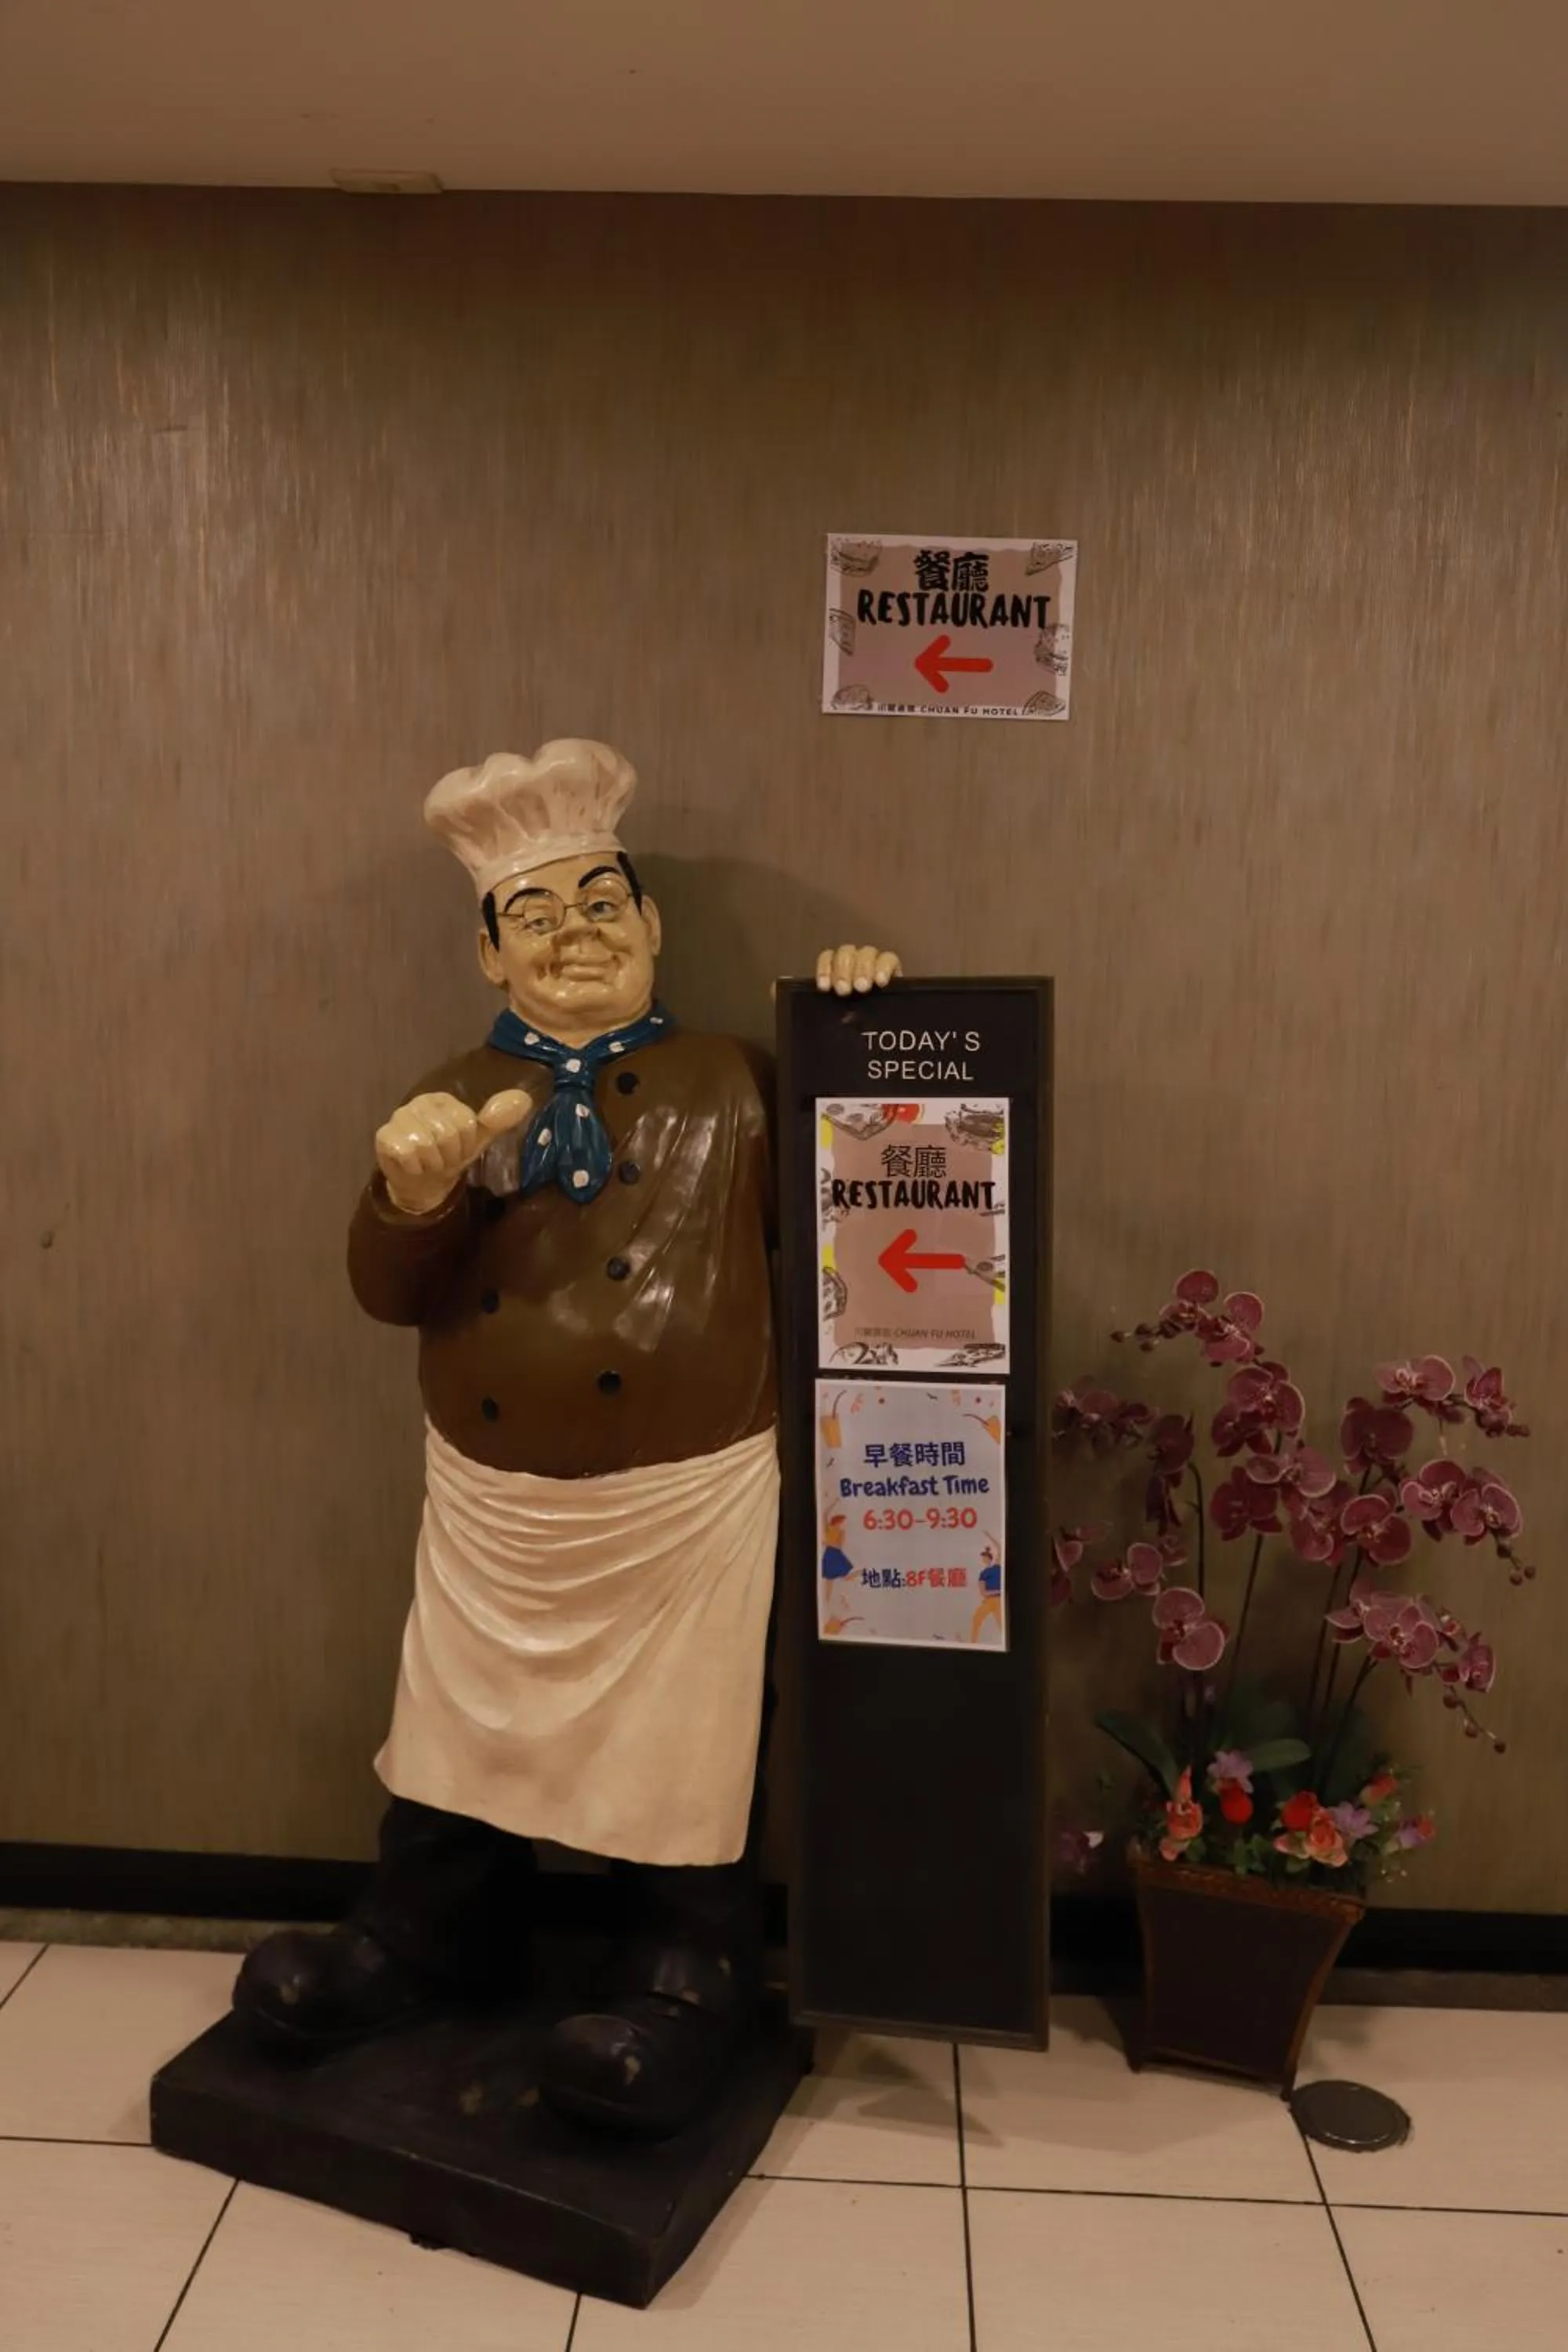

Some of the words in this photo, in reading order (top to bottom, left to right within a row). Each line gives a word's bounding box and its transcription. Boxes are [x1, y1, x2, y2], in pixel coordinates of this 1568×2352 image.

[913, 549, 990, 592] 餐廳
[857, 589, 1051, 629] RESTAURANT
[868, 1060, 975, 1081] SPECIAL
[880, 1144, 947, 1179] 餐廳
[832, 1179, 996, 1210] RESTAURANT
[864, 1442, 965, 1468] 早餐時間
[840, 1475, 939, 1497] Breakfast
[942, 1475, 989, 1495] Time
[863, 1507, 978, 1530] 6:30-9:30
